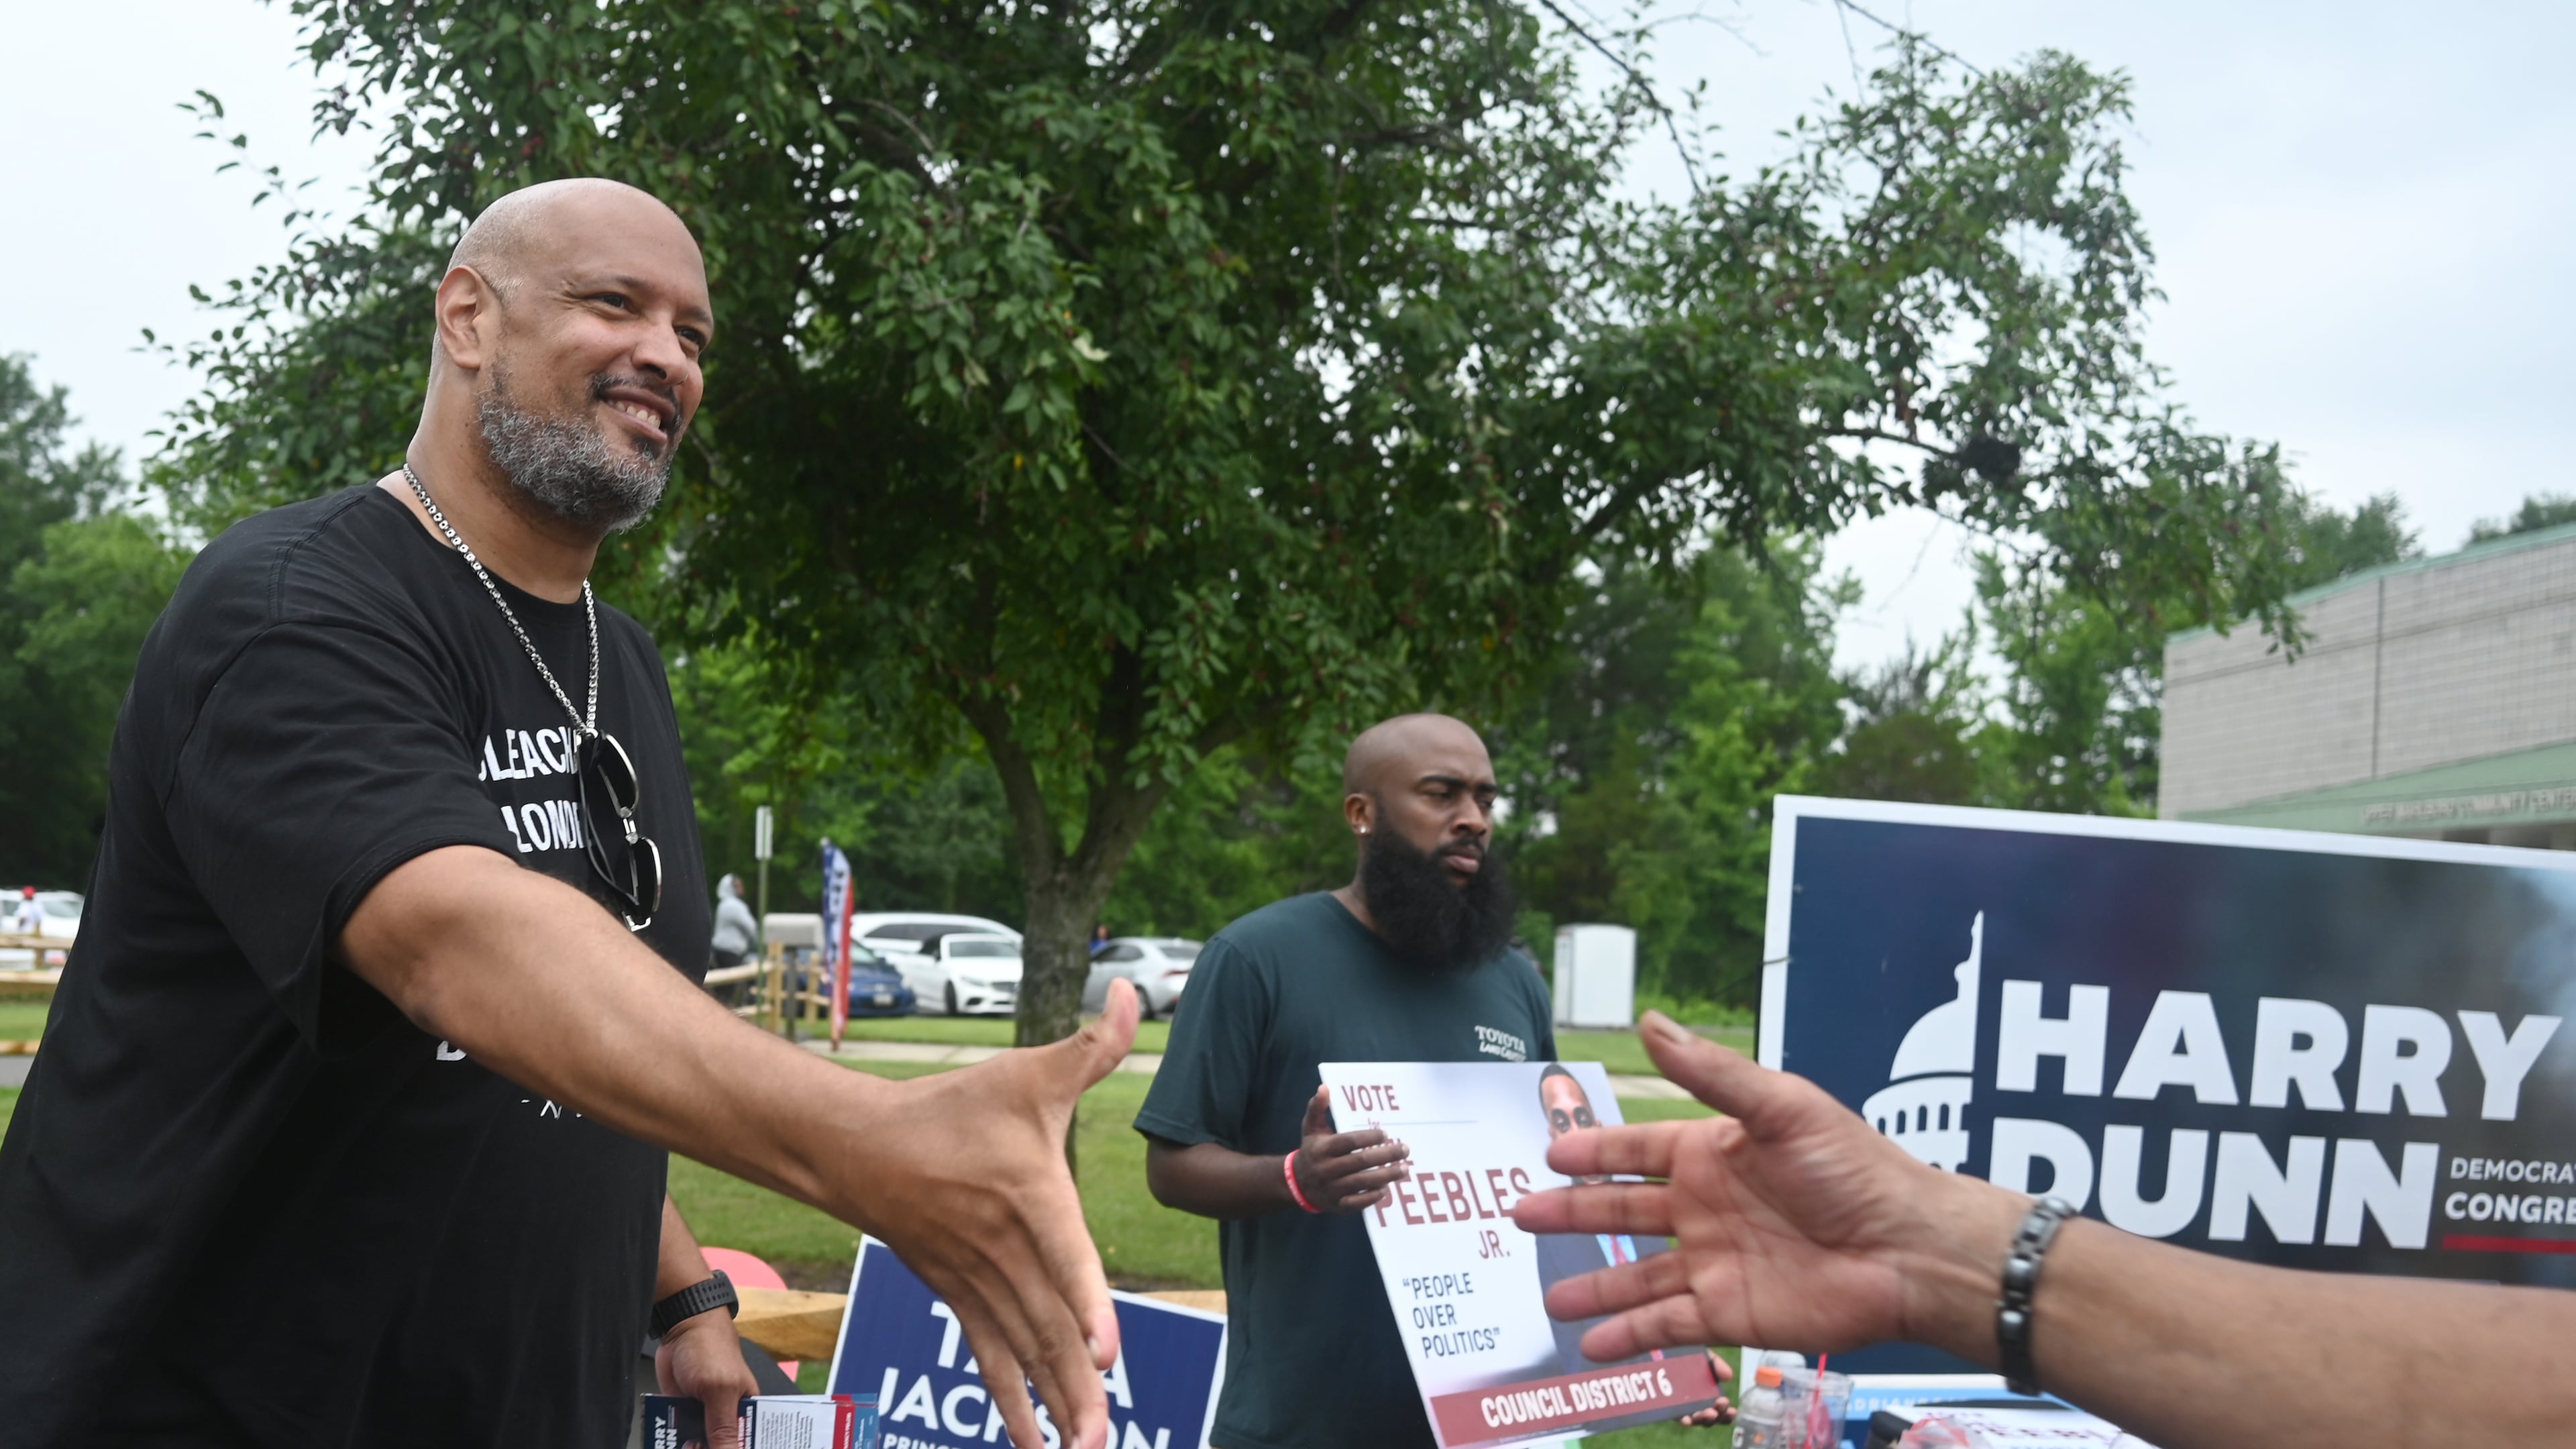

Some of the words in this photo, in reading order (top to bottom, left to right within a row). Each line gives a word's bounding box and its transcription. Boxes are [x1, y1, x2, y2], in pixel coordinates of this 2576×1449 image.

[1474, 1024, 1525, 1054] TOYOTA
[1996, 979, 2562, 1121] HARRY
[1342, 1084, 1399, 1113] VOTE
[1990, 1117, 2440, 1249] DUNN
[2451, 1157, 2576, 1184] DEMOCRA
[1479, 1230, 1511, 1259] JR.
[1403, 1273, 1474, 1299] “PEOPLE
[1413, 1303, 1457, 1330] OVER
[1421, 1327, 1501, 1358] POLITICS”
[1481, 1392, 1572, 1428] COUNCIL
[1569, 1370, 1654, 1413] DISTRICT
[1657, 1368, 1672, 1397] 6
